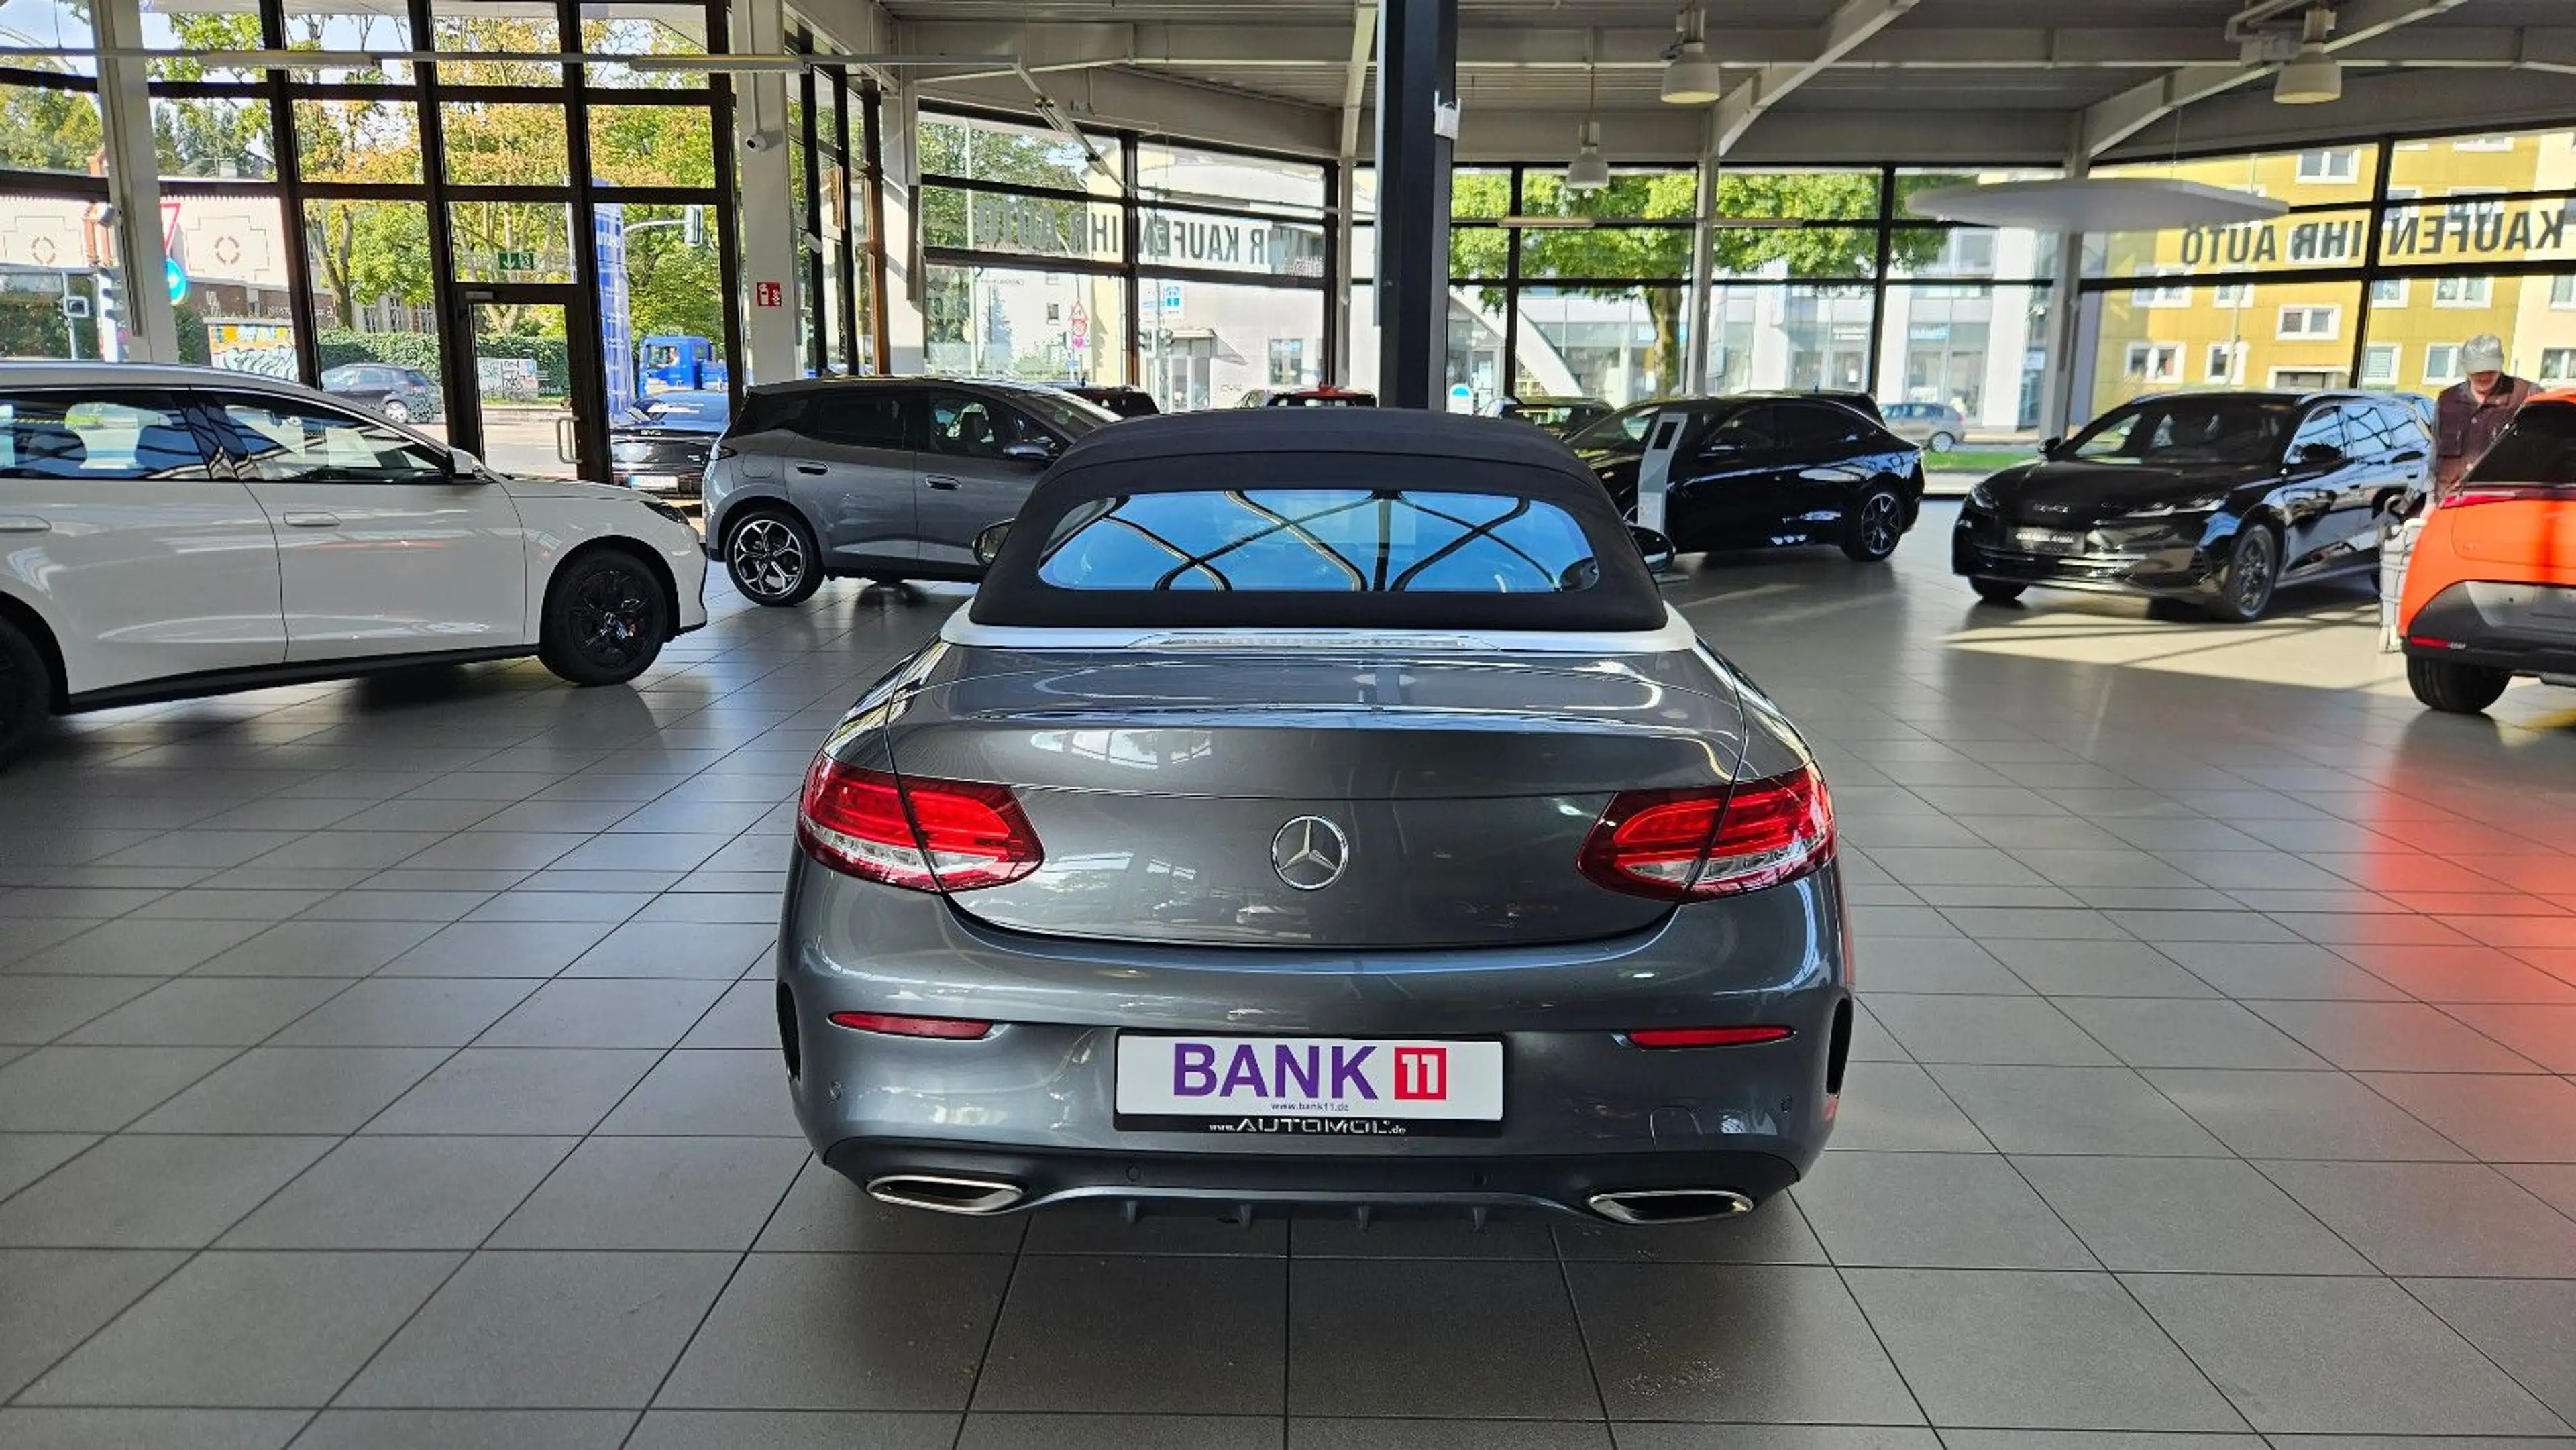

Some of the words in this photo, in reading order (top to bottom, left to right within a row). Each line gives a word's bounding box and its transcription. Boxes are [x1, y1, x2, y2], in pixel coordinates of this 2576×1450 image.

[1173, 1043, 1379, 1100] BANK
[1400, 1052, 1440, 1095] 11
[1271, 1102, 1350, 1112] www.bank11.de
